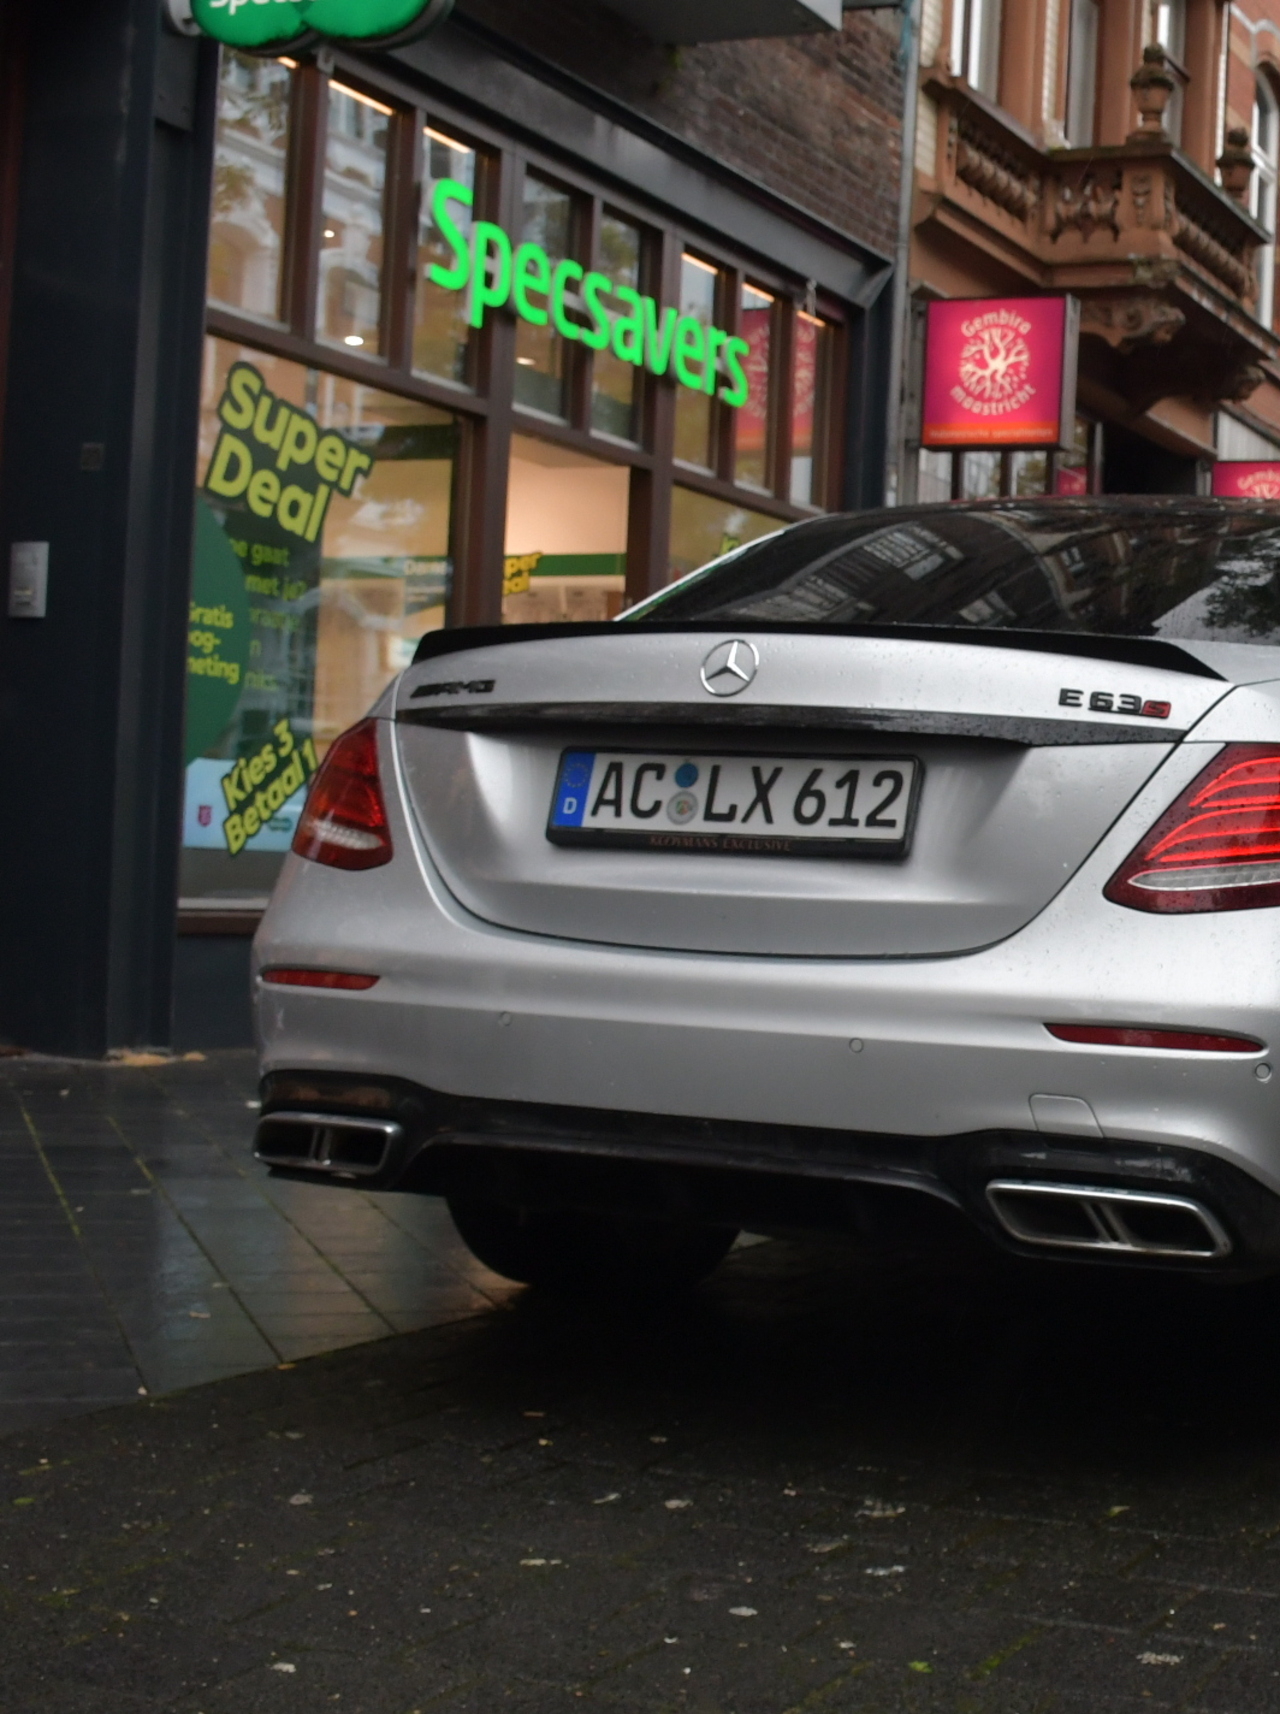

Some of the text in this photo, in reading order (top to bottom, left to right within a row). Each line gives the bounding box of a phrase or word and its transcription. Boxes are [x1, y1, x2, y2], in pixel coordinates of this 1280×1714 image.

[429, 177, 749, 408] Specsavers
[961, 308, 1032, 338] Gembira
[220, 367, 371, 491] Super
[207, 432, 330, 543] Deal
[222, 719, 294, 811] Kies 3
[224, 739, 317, 855] Betaal 1
[562, 797, 578, 815] D
[590, 761, 904, 828] AC LX 612
